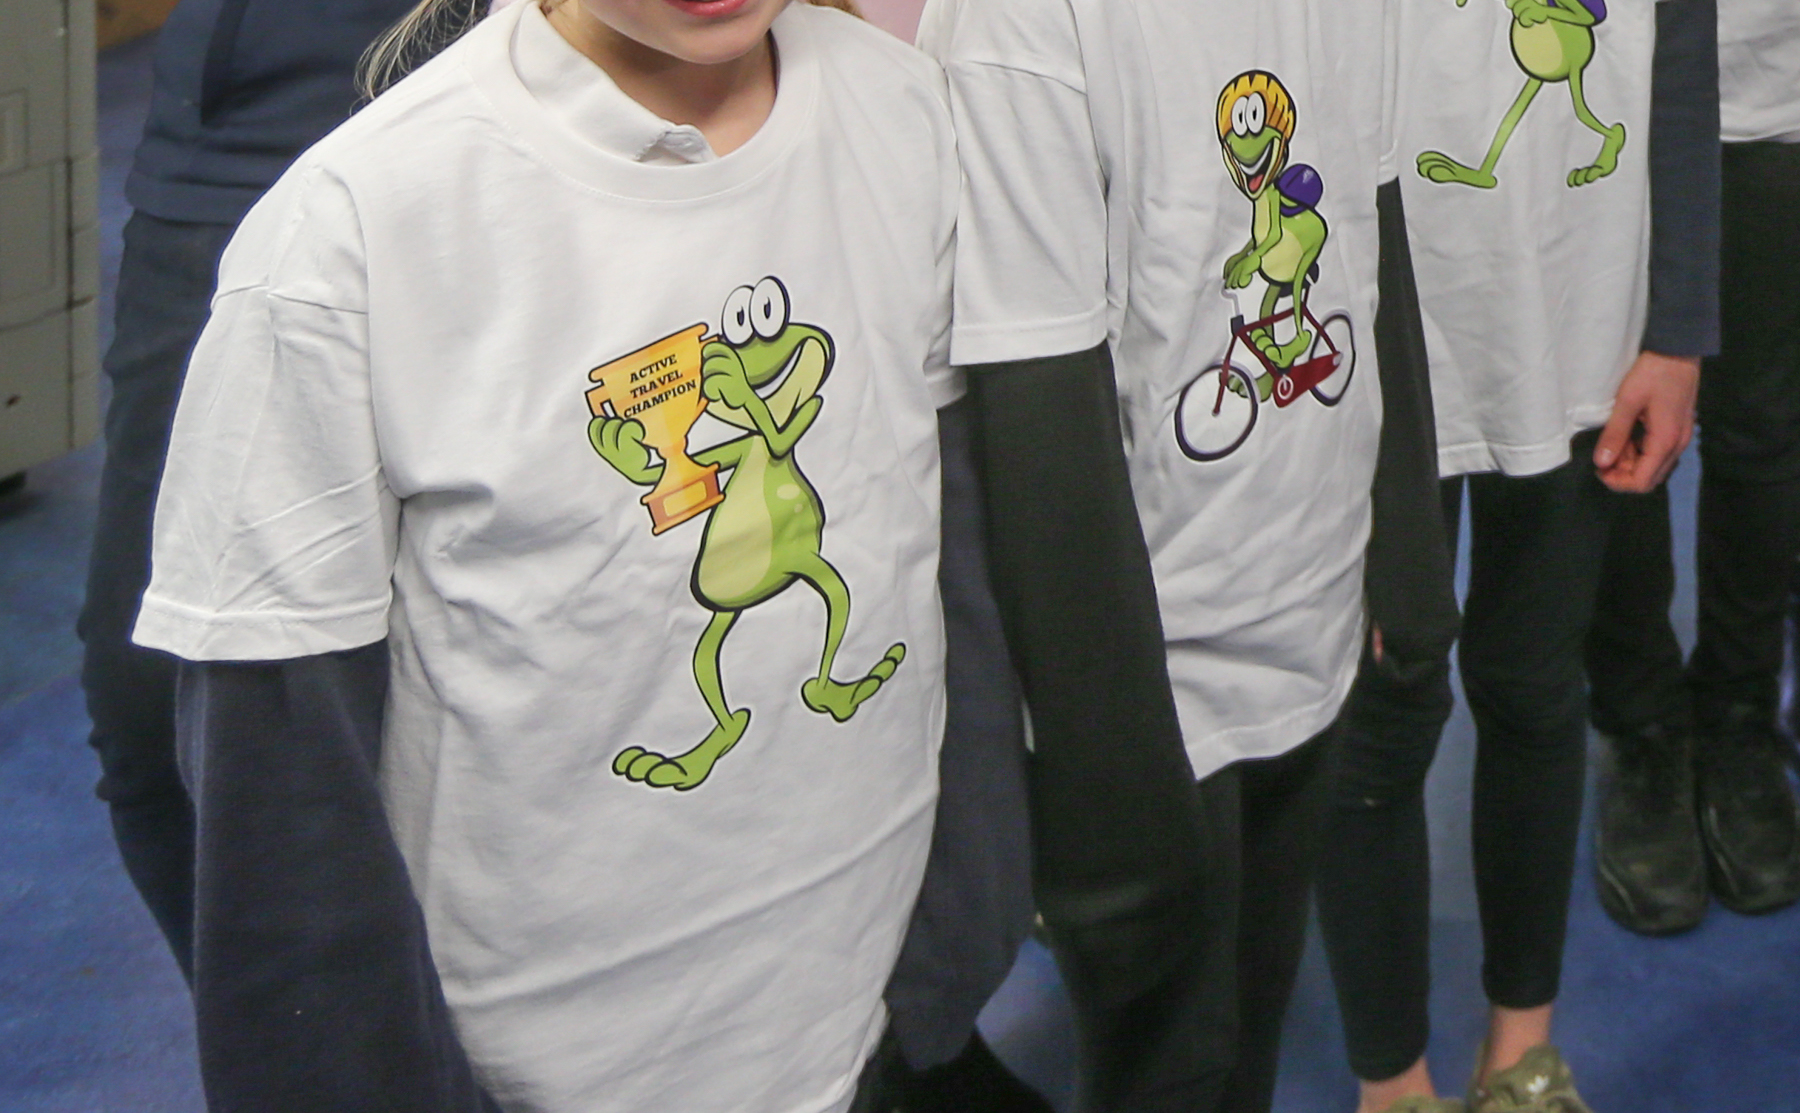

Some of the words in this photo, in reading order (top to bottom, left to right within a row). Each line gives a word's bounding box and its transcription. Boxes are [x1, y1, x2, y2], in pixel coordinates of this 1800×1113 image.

[630, 354, 677, 383] ACTIVE
[624, 379, 697, 418] CHAMPION
[630, 370, 683, 399] TRAVEL
